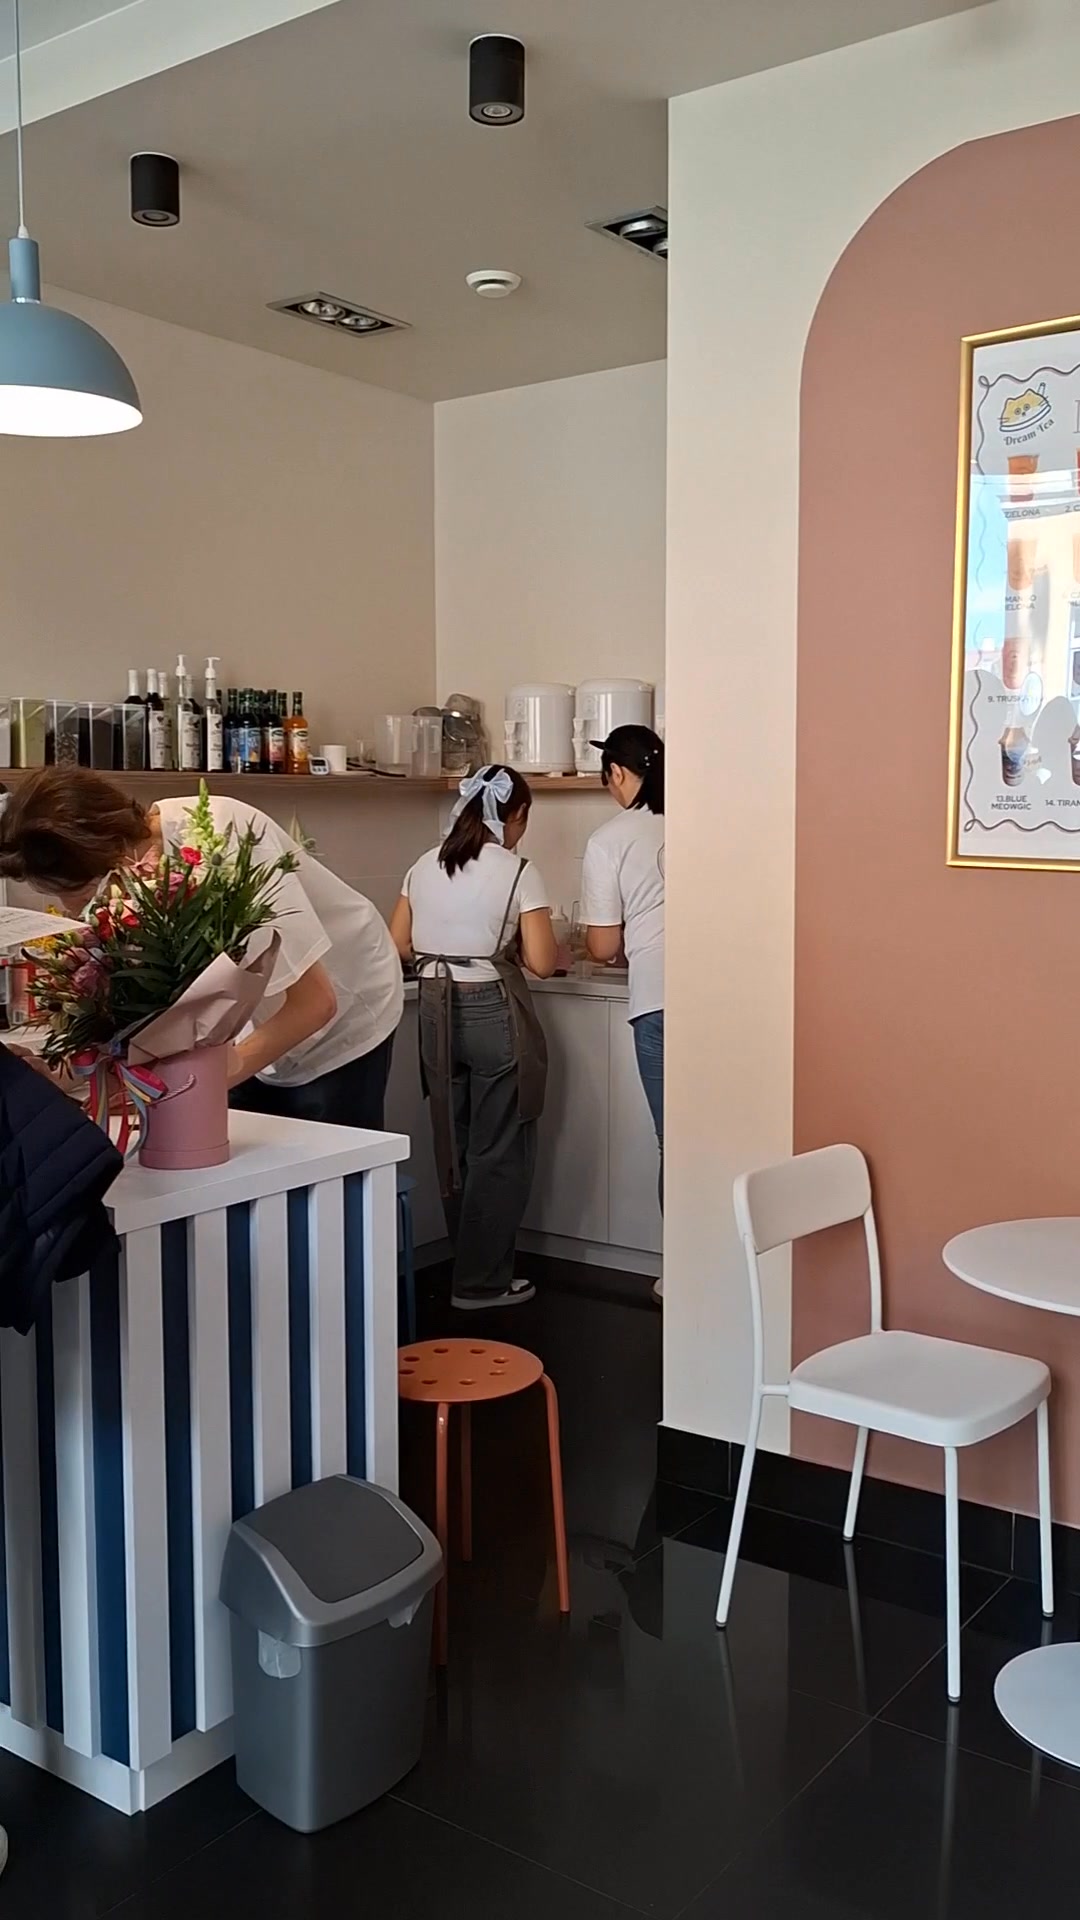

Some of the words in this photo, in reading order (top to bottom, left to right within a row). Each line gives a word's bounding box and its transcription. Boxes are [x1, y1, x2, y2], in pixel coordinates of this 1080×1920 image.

[1003, 431, 1037, 446] Dream
[1036, 419, 1055, 432] Tea
[1005, 594, 1037, 603] MANO
[991, 803, 1032, 811] MEOWGIC
